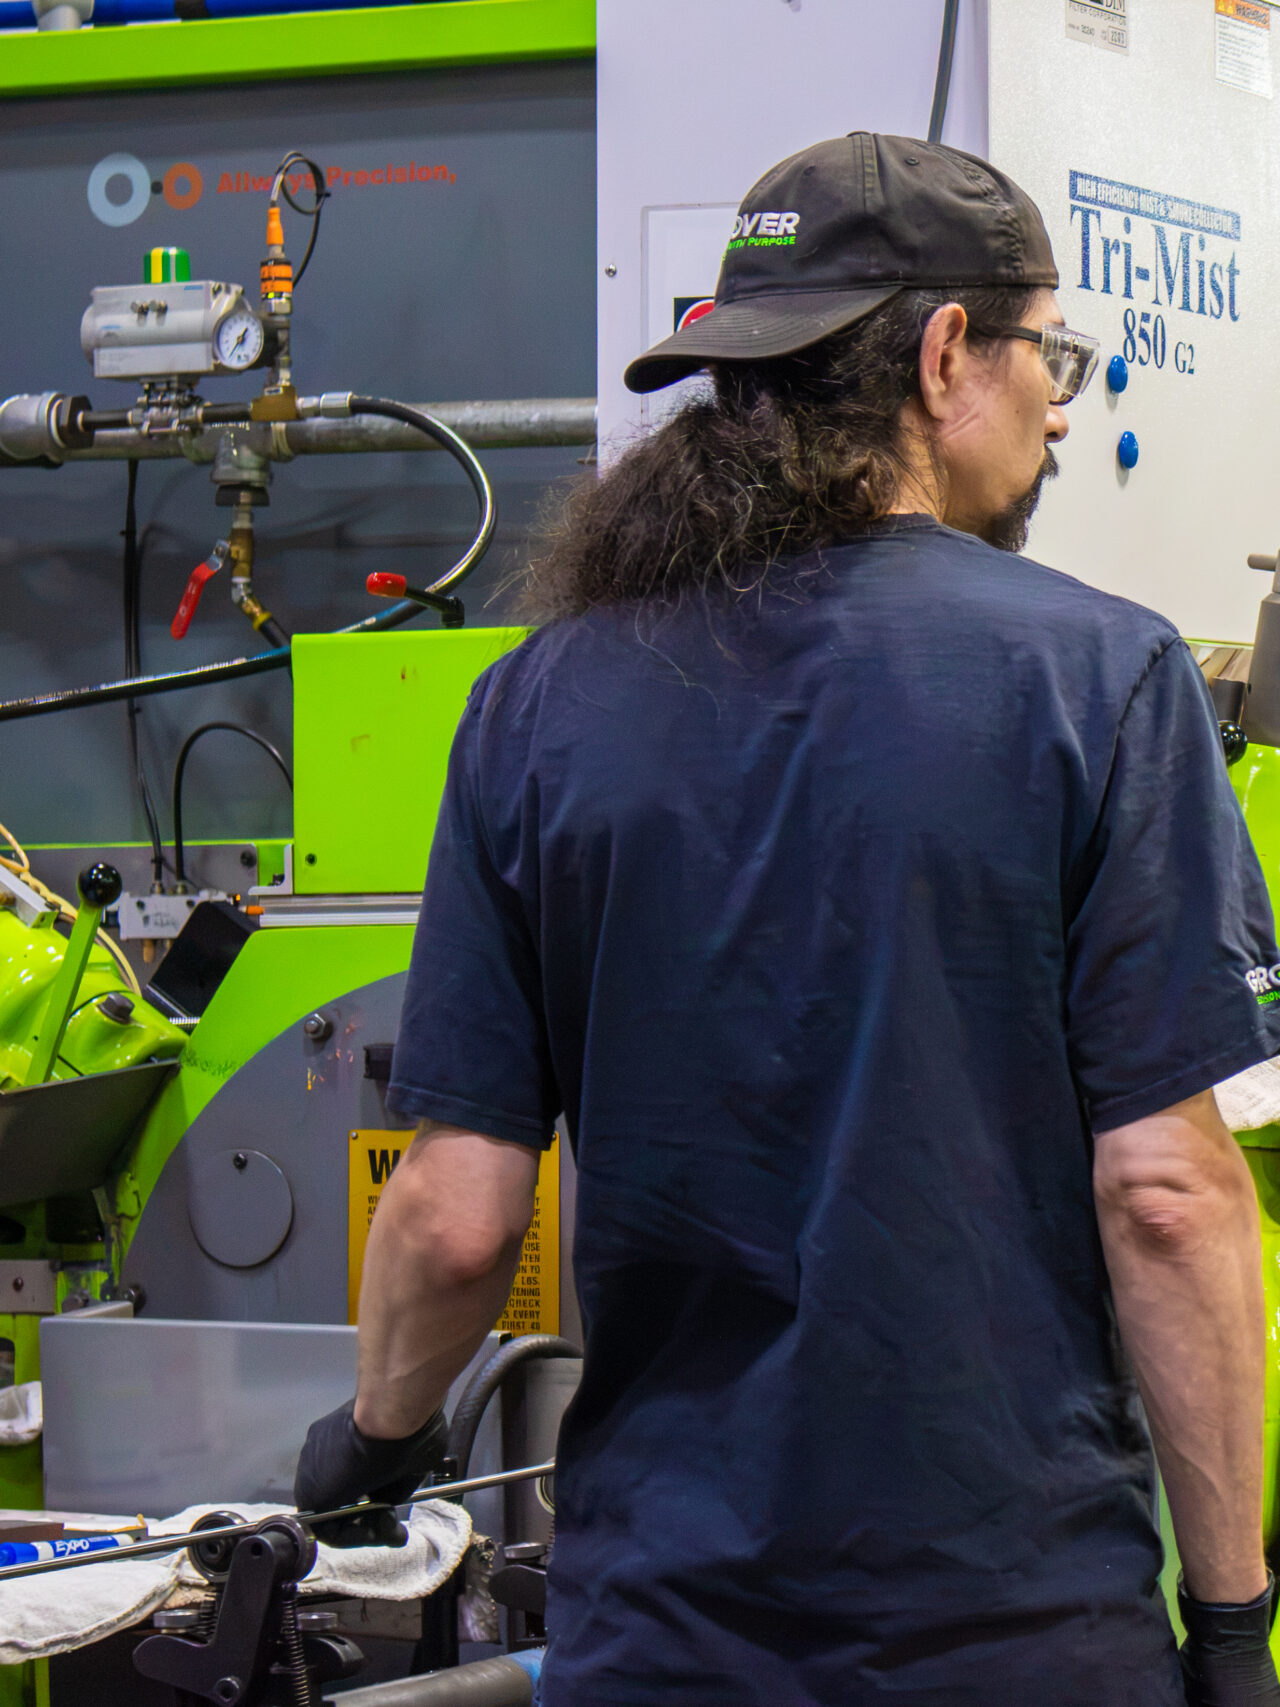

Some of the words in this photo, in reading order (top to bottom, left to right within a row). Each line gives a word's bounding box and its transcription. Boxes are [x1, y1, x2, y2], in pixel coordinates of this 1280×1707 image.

[217, 171, 319, 196] Allwys
[327, 161, 456, 187] Precision,
[747, 236, 796, 247] PURPOSE
[1070, 204, 1240, 322] Tri-Mist
[1123, 308, 1166, 369] 850
[1174, 341, 1195, 375] G2
[525, 1241, 541, 1252] USE
[530, 1264, 541, 1274] TO
[514, 1309, 541, 1320] EVERY
[502, 1320, 525, 1331] FIRST
[55, 1539, 90, 1557] EXPO
